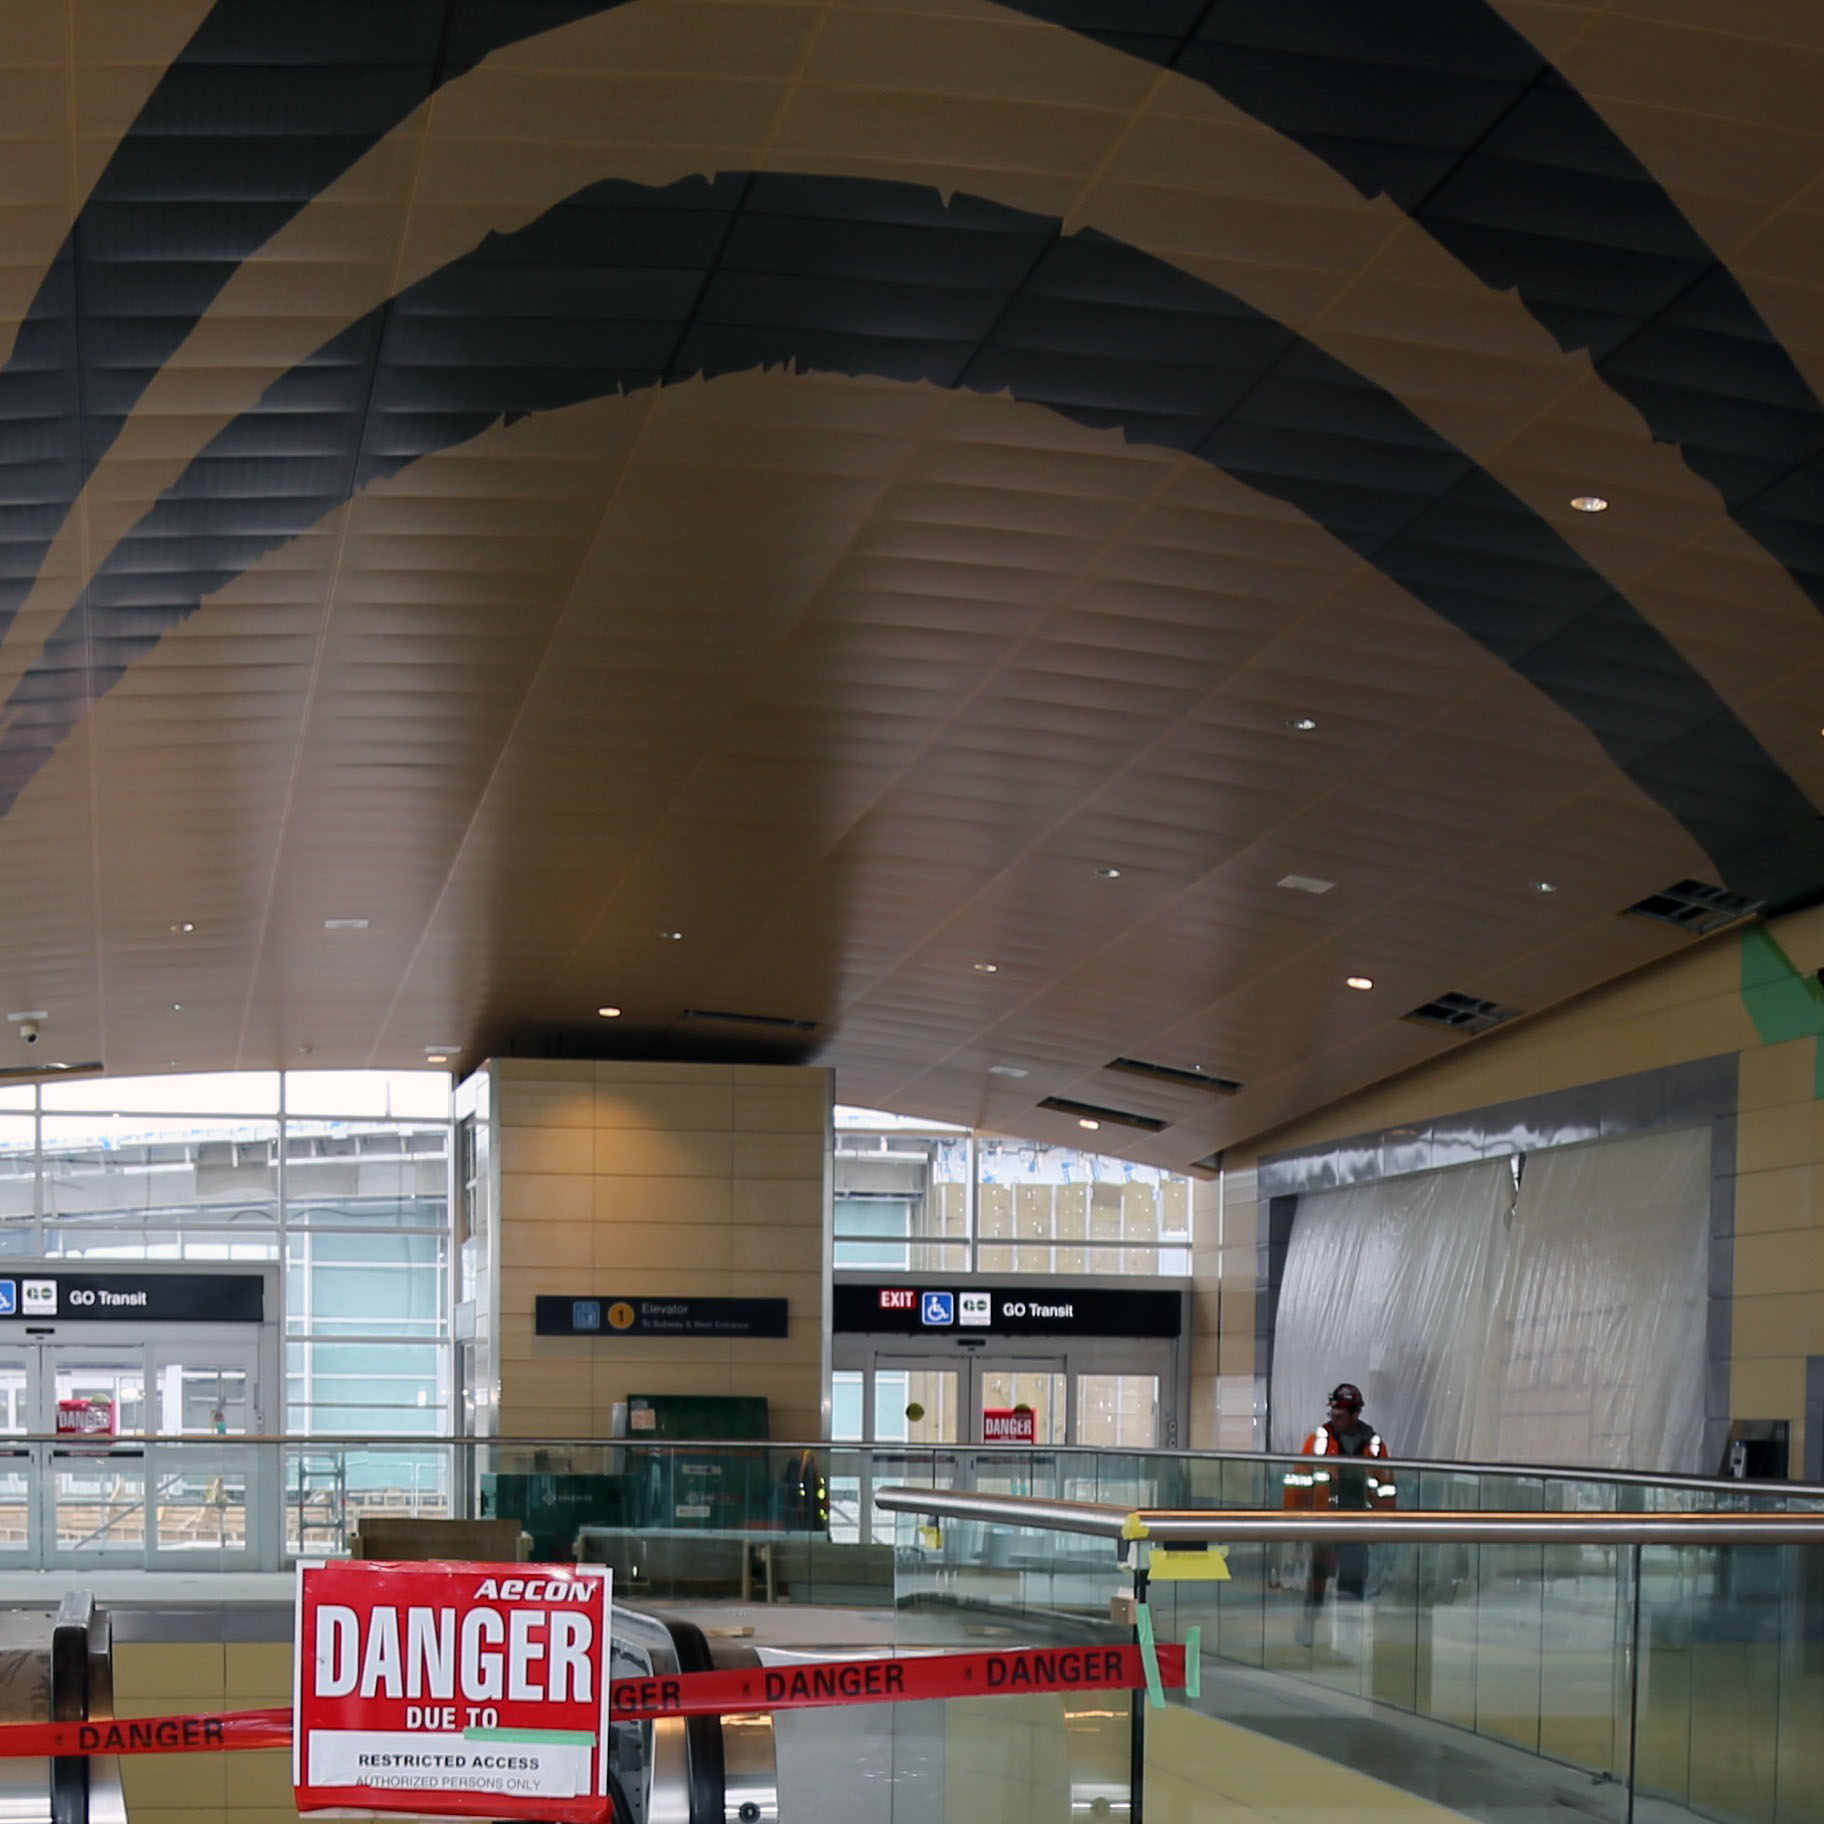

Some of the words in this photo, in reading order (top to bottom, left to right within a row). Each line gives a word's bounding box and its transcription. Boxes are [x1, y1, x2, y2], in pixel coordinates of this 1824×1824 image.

[69, 1290, 95, 1306] GO
[97, 1290, 147, 1306] Transit
[880, 1291, 914, 1308] EXIT
[616, 1309, 624, 1322] 1
[641, 1303, 689, 1315] Elevator
[1003, 1303, 1026, 1318] GO
[1029, 1303, 1074, 1318] Transit
[58, 1410, 111, 1428] DANGER
[986, 1418, 1032, 1435] DANGER
[315, 1605, 593, 1703] DANGER
[614, 1681, 681, 1712] GER
[765, 1664, 905, 1702] DANGER
[986, 1651, 1125, 1688] DANGER
[406, 1706, 456, 1729] DUE
[465, 1707, 498, 1730] TO
[79, 1718, 225, 1750] DANGER
[358, 1754, 466, 1769] RESTRICTED
[471, 1756, 540, 1770] ACCESS
[355, 1776, 439, 1788] AUTHORIZED
[441, 1776, 504, 1790] PERSONS
[506, 1778, 542, 1791] ONLY
